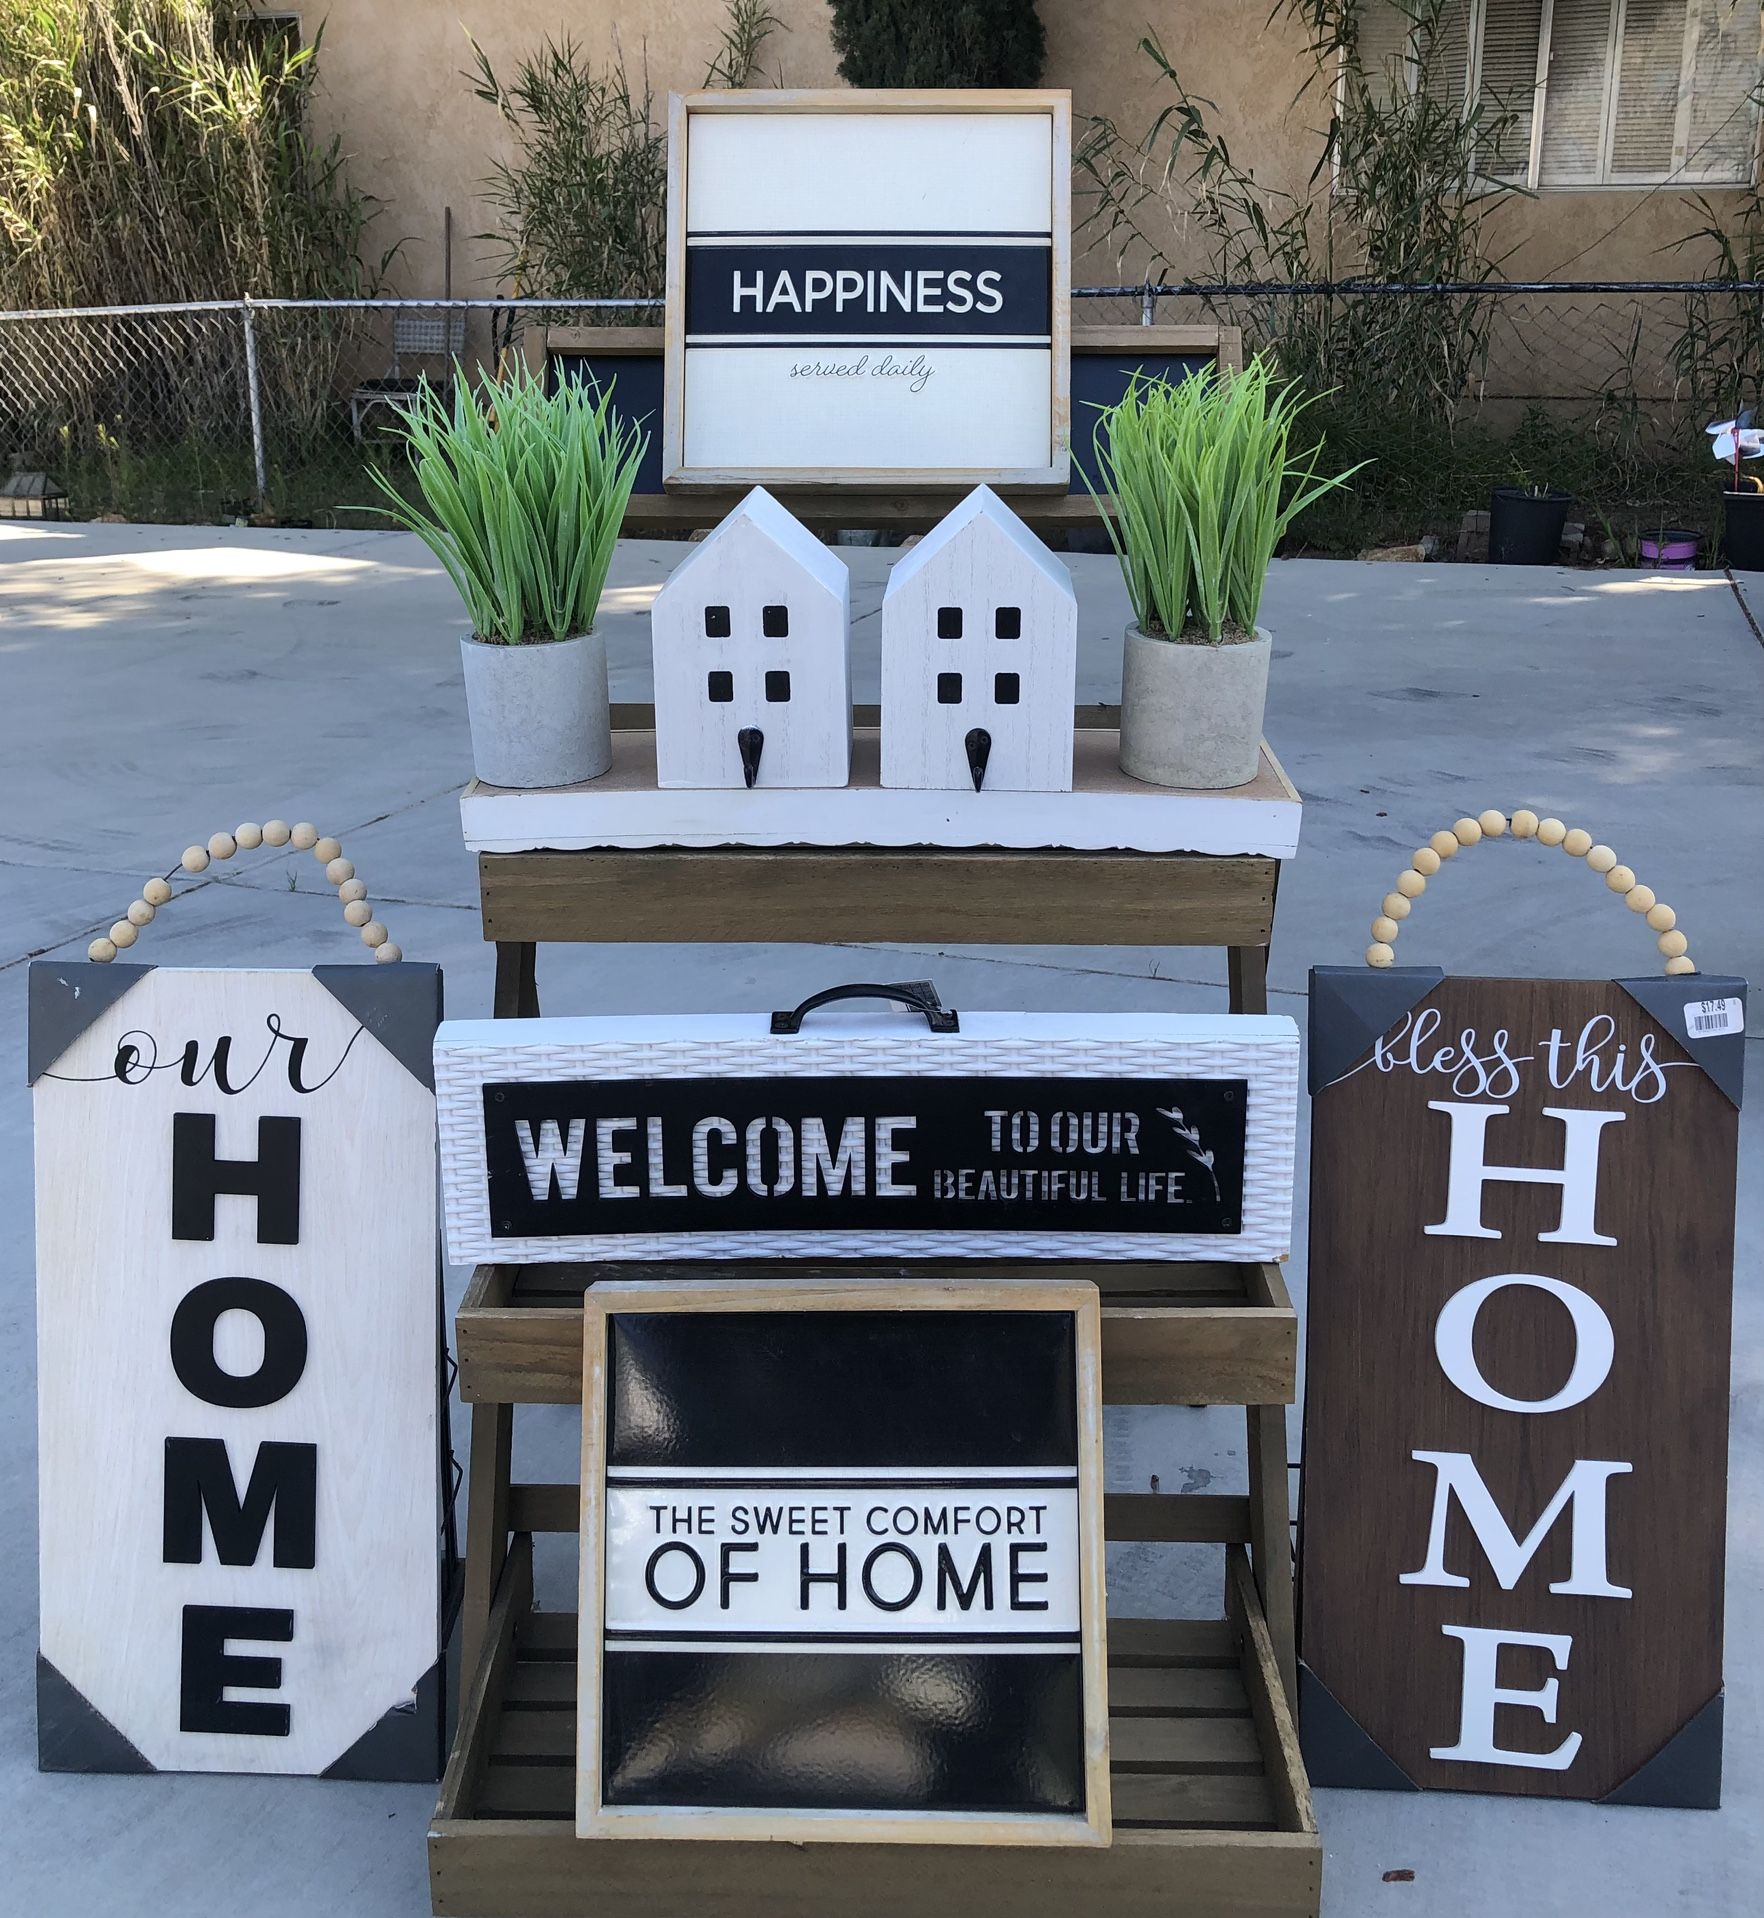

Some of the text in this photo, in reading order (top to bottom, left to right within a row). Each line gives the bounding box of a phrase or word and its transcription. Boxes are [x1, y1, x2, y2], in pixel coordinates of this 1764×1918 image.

[732, 270, 1004, 314] HAPPINESS
[790, 355, 936, 393] served daily
[1701, 999, 1726, 1013] $17.49
[42, 1013, 365, 1096] our
[1326, 1008, 1702, 1103] bless this
[514, 1115, 918, 1201] WELCOME
[984, 1110, 1141, 1155] TO OUR
[933, 1168, 1107, 1202] BEAUTIFUL
[162, 1111, 319, 1737] HOME
[1398, 1099, 1634, 1772] HOME
[649, 1504, 1049, 1536] THE SWEET COMFORT
[644, 1540, 1050, 1612] OF HOME
